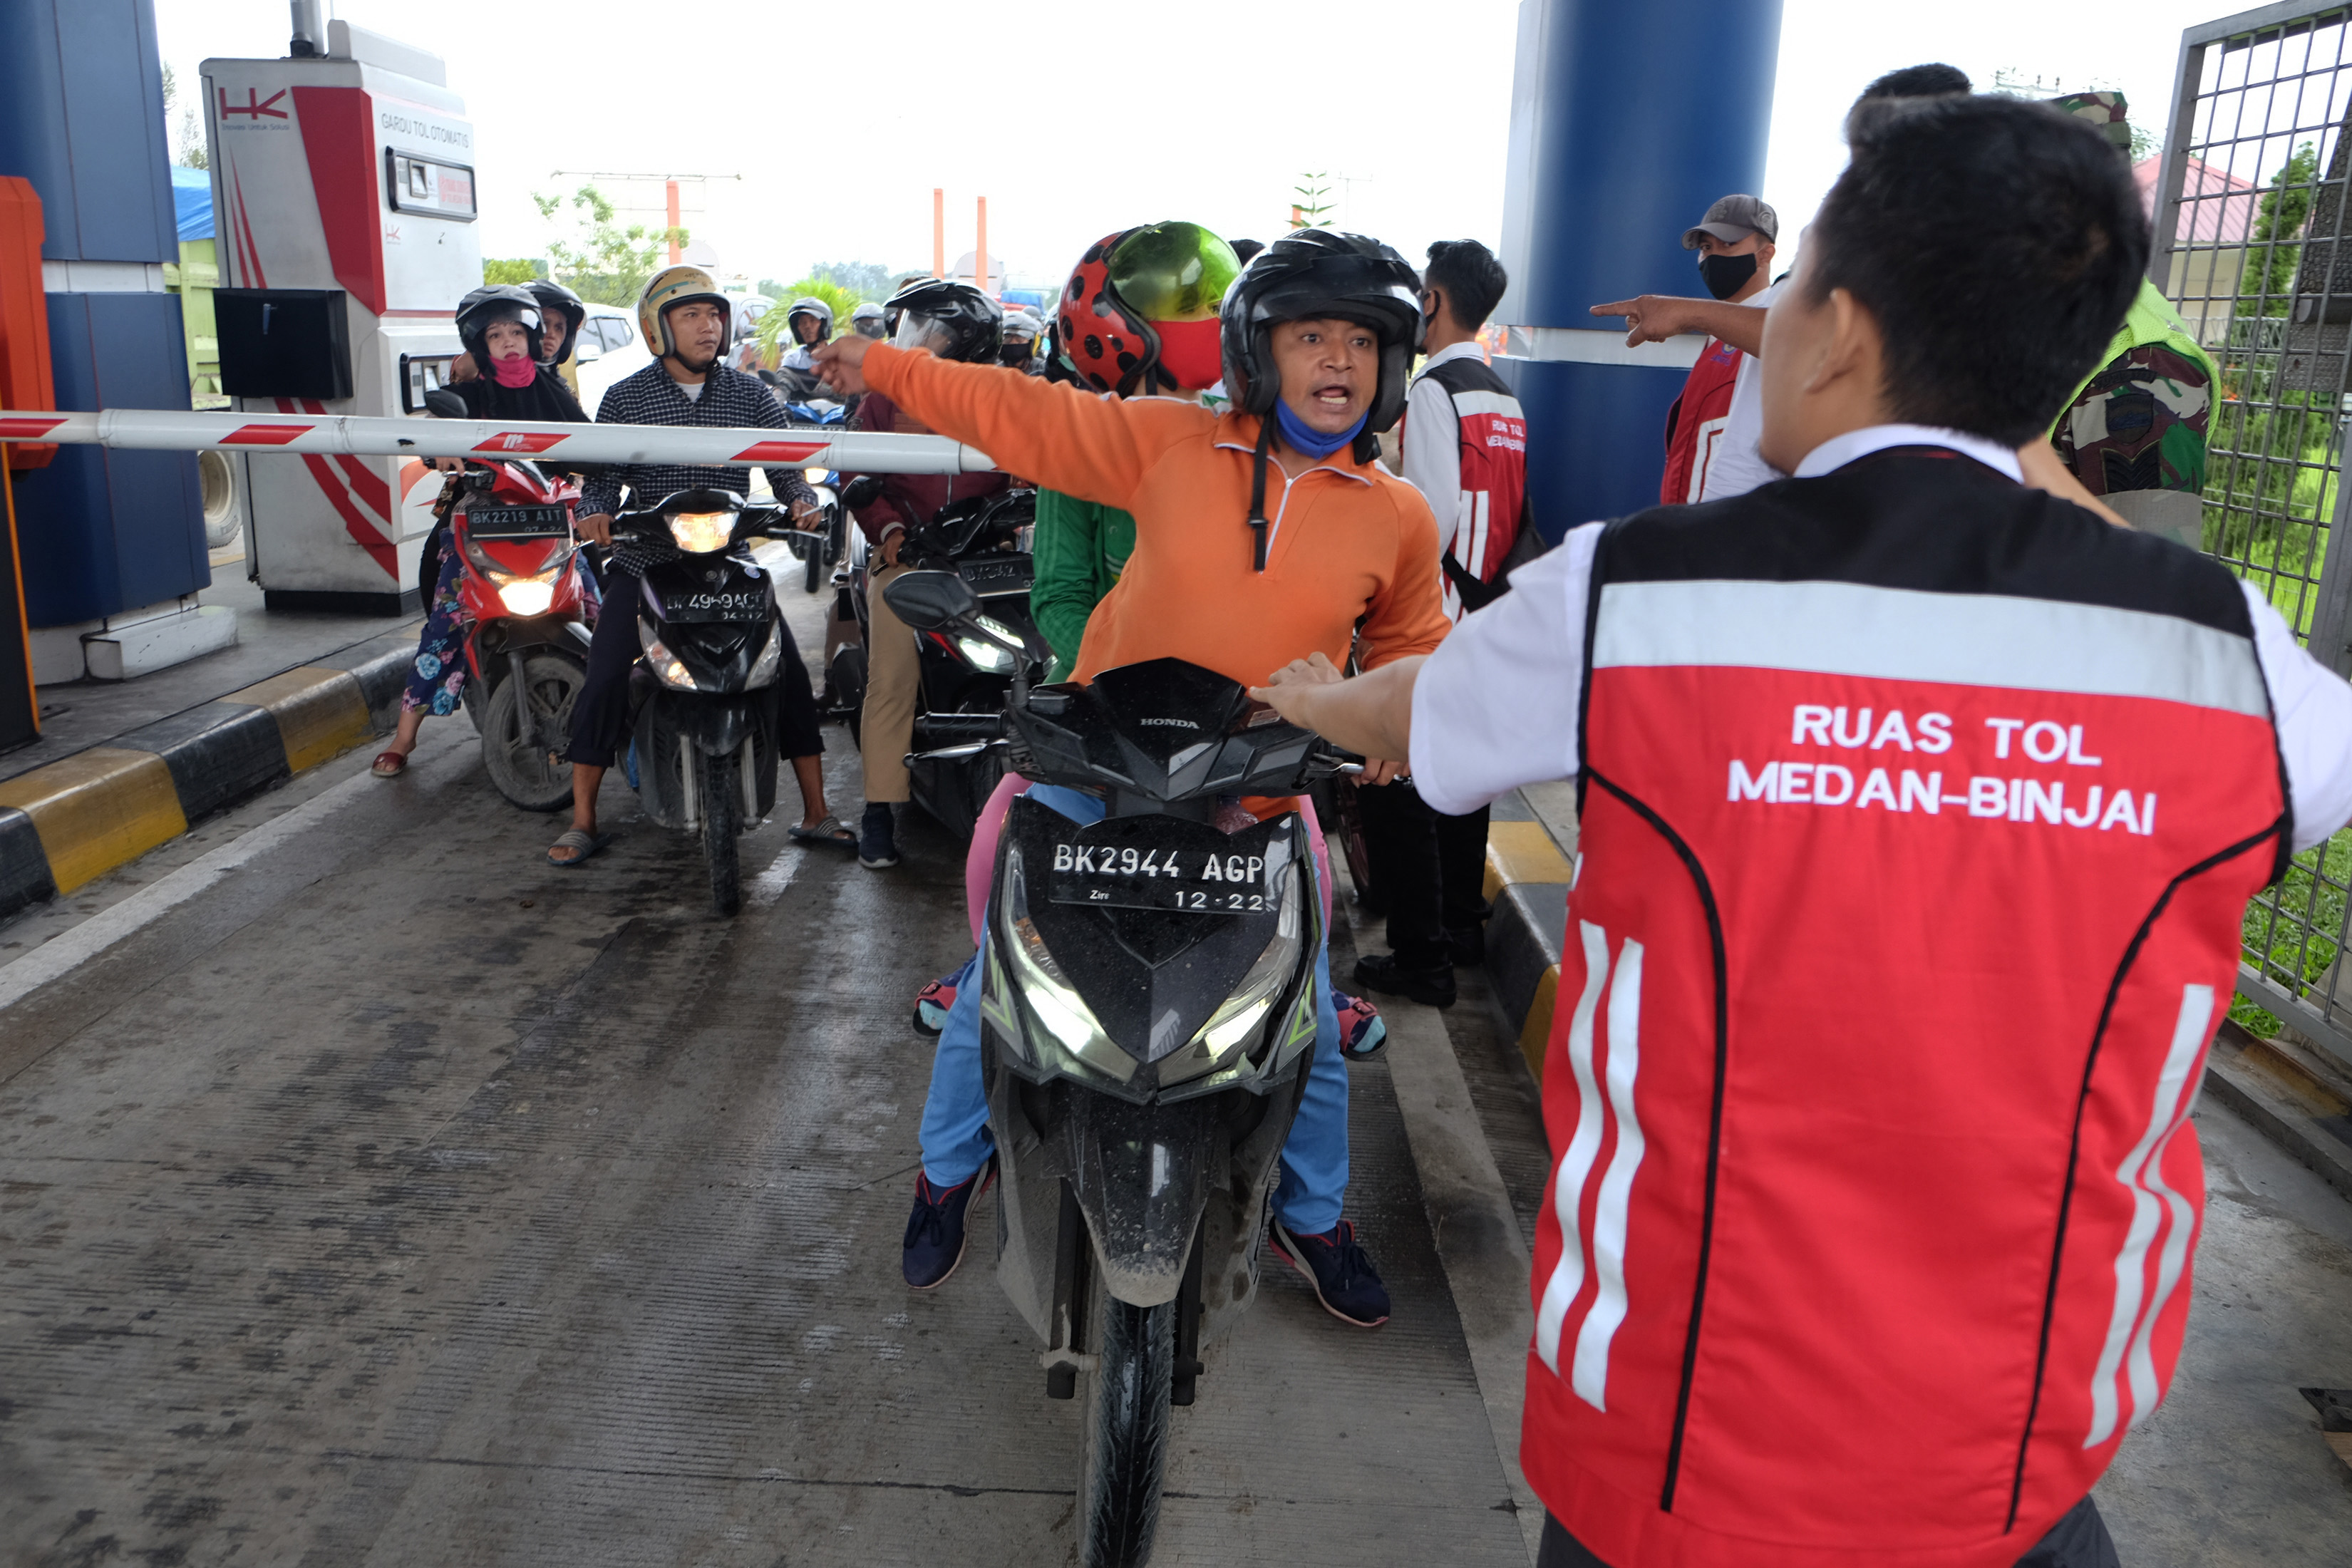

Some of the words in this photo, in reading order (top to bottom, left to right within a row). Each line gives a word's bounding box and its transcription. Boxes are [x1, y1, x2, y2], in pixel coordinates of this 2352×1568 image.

[381, 113, 412, 135] GARDU
[413, 120, 430, 138] TOL
[430, 125, 469, 149] OTOMATIS
[1140, 718, 1200, 730] HONDA
[1792, 704, 1953, 754] RUAS
[1985, 718, 2102, 766] TOL
[1728, 759, 2157, 835] MEDAN-BINJAI
[1053, 844, 1180, 877] BK2944
[1202, 853, 1264, 883] AGP
